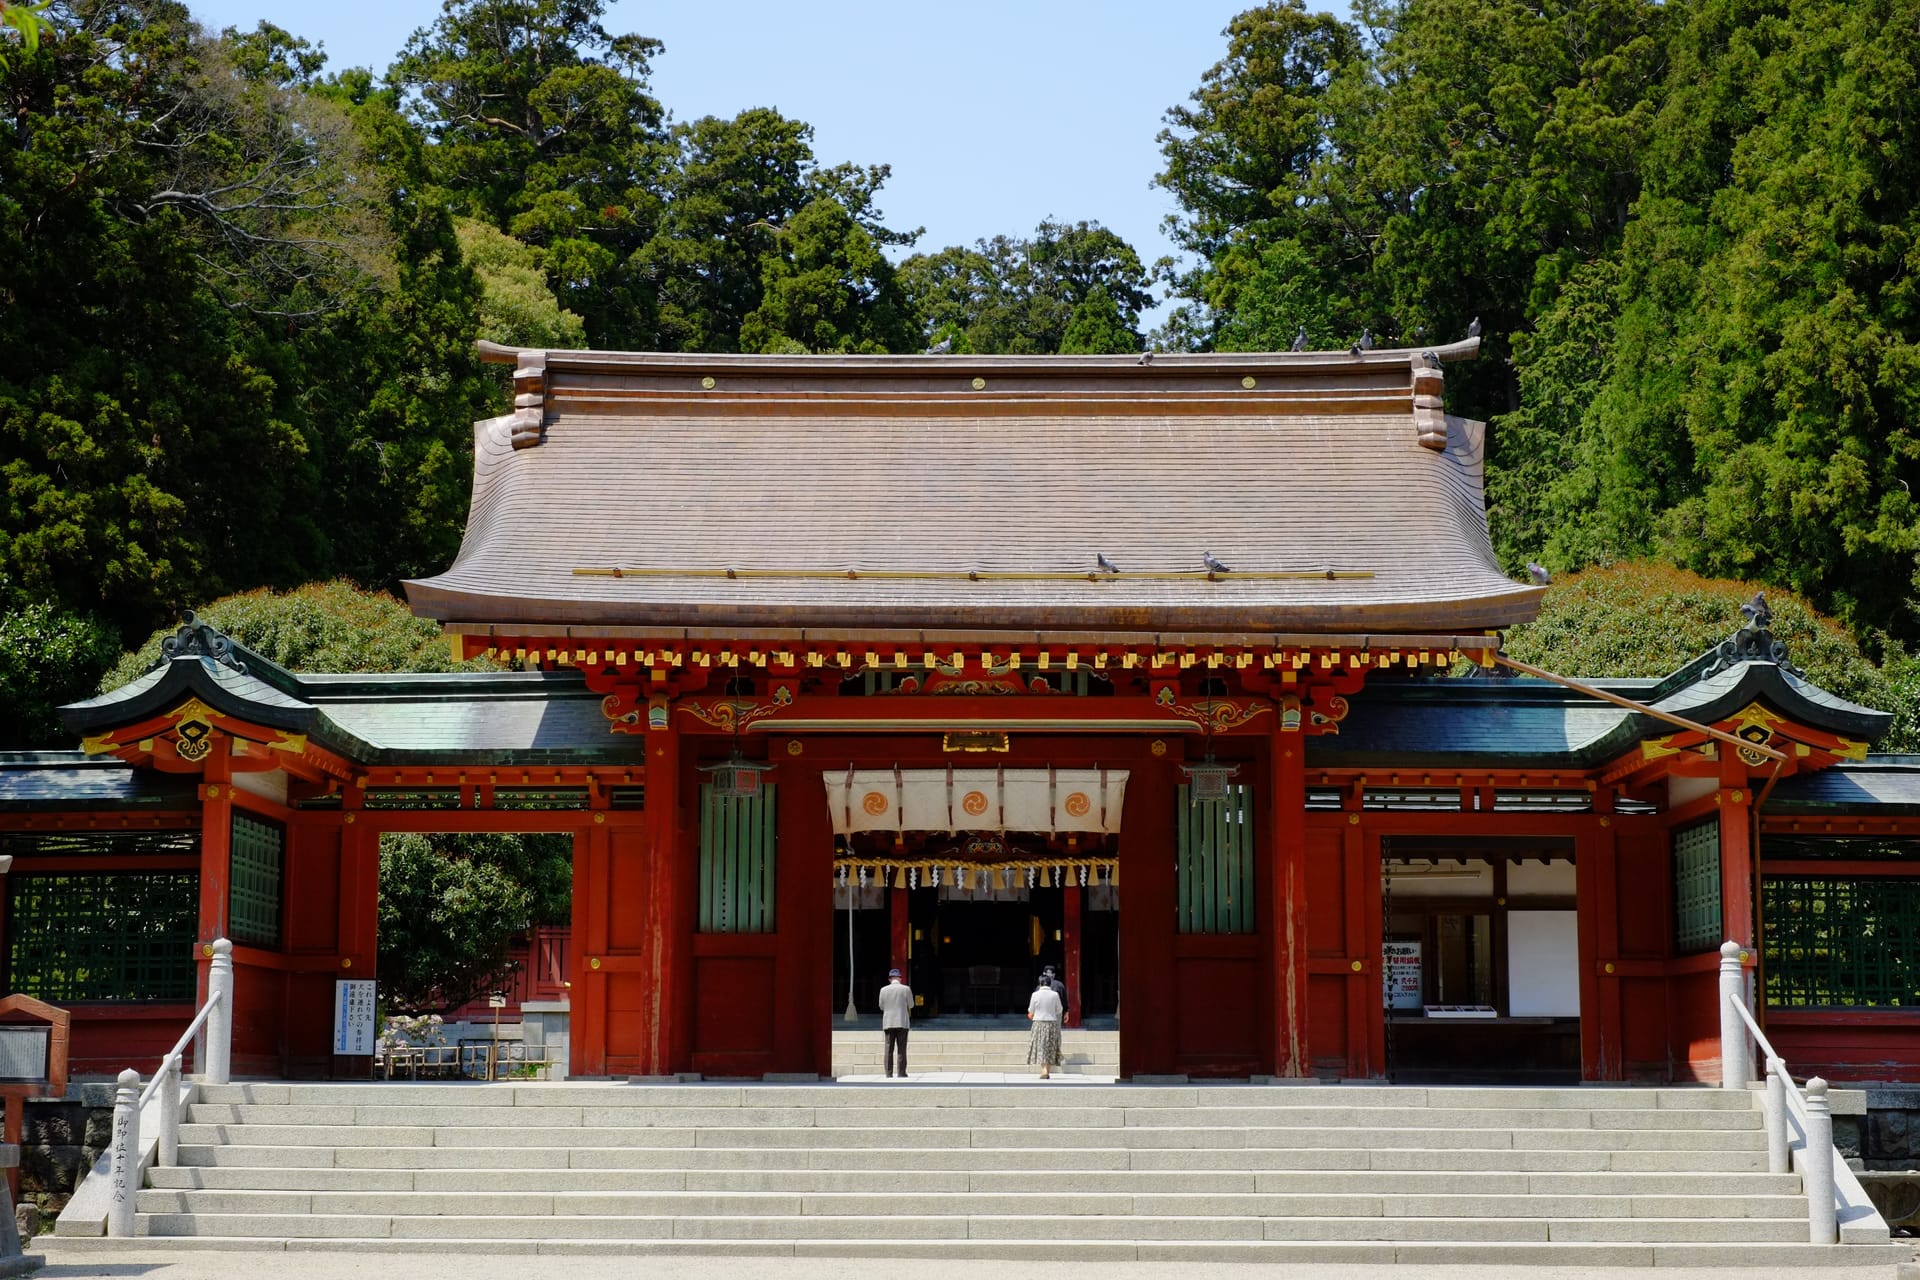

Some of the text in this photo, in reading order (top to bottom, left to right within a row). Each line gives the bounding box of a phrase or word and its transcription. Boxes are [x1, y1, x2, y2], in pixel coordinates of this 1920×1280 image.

[348, 983, 356, 1027] 御遠慮下さい
[113, 1115, 129, 1203] 御即位十年記念
